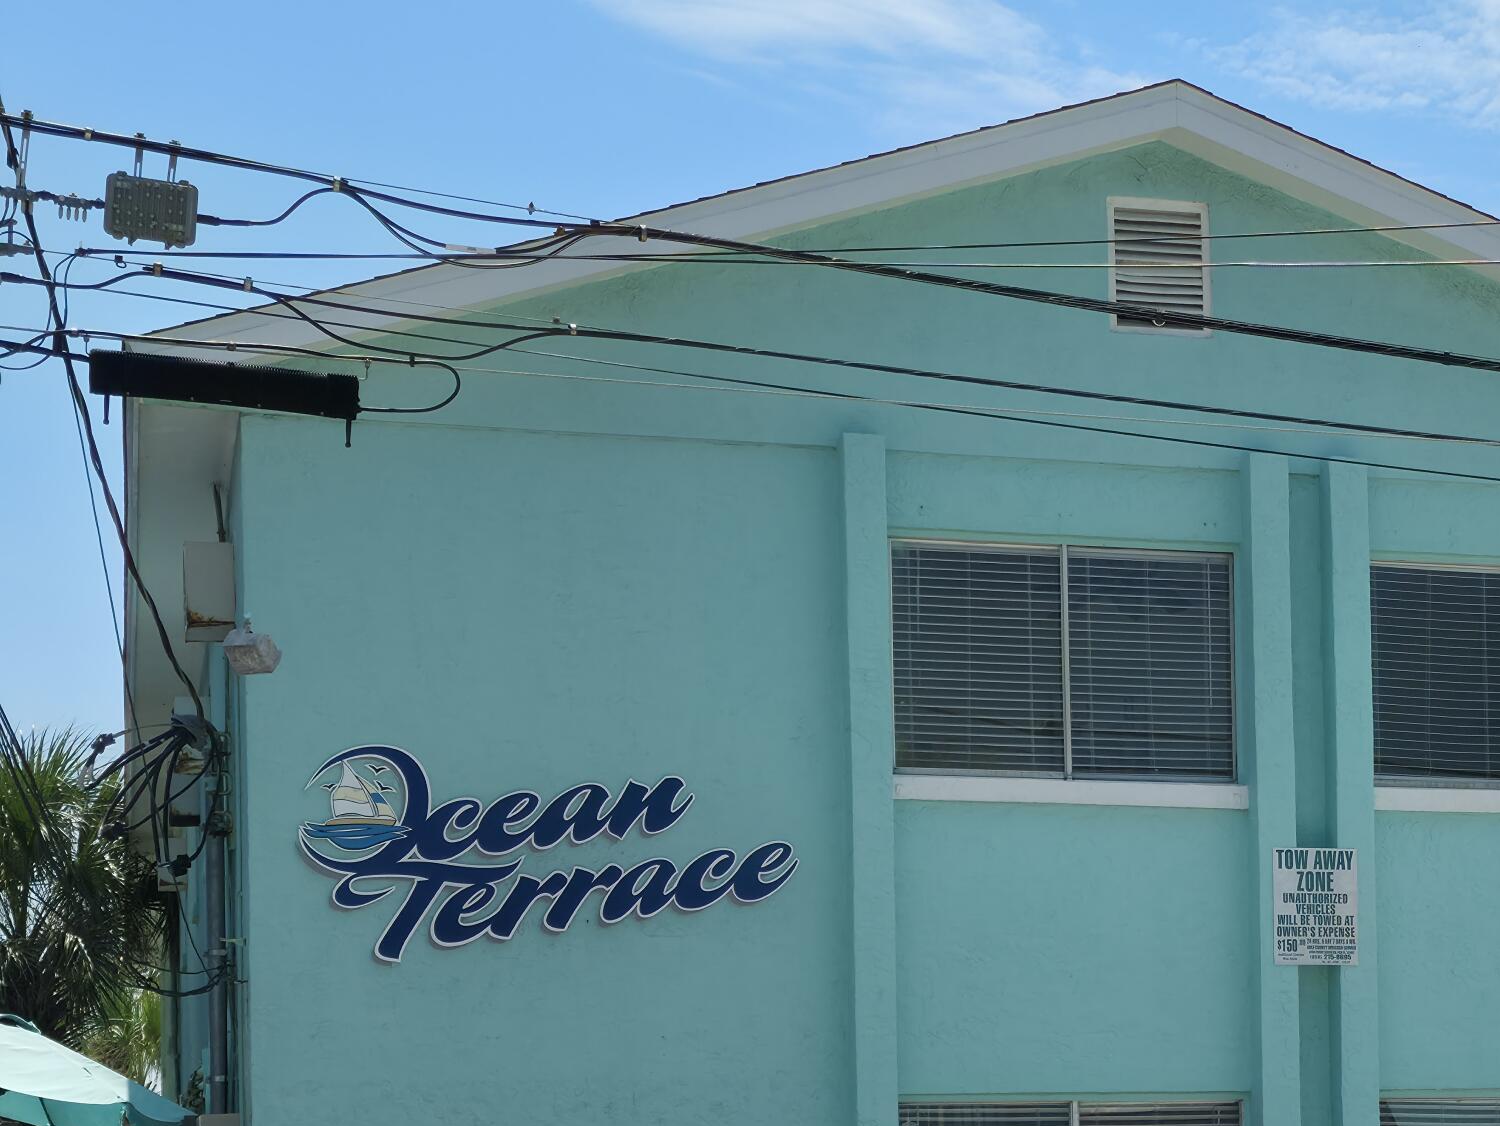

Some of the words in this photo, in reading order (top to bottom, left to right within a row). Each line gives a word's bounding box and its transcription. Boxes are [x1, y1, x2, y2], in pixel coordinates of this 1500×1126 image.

[299, 744, 695, 874] Ocean
[1275, 849, 1309, 870] TOW
[1313, 850, 1354, 870] AWAY
[1296, 871, 1334, 892] ZONE
[333, 841, 799, 962] Terrace
[1282, 892, 1348, 904] UNAUTHORIZED
[1295, 904, 1336, 914] VEHICLES
[1277, 914, 1298, 925] WILL
[1300, 914, 1311, 925] BE
[1312, 914, 1342, 925] TOWED
[1344, 915, 1355, 926] AT
[1276, 926, 1316, 937] OWNER'S
[1318, 926, 1356, 938] EXPENSE
[1277, 938, 1298, 952] $150
